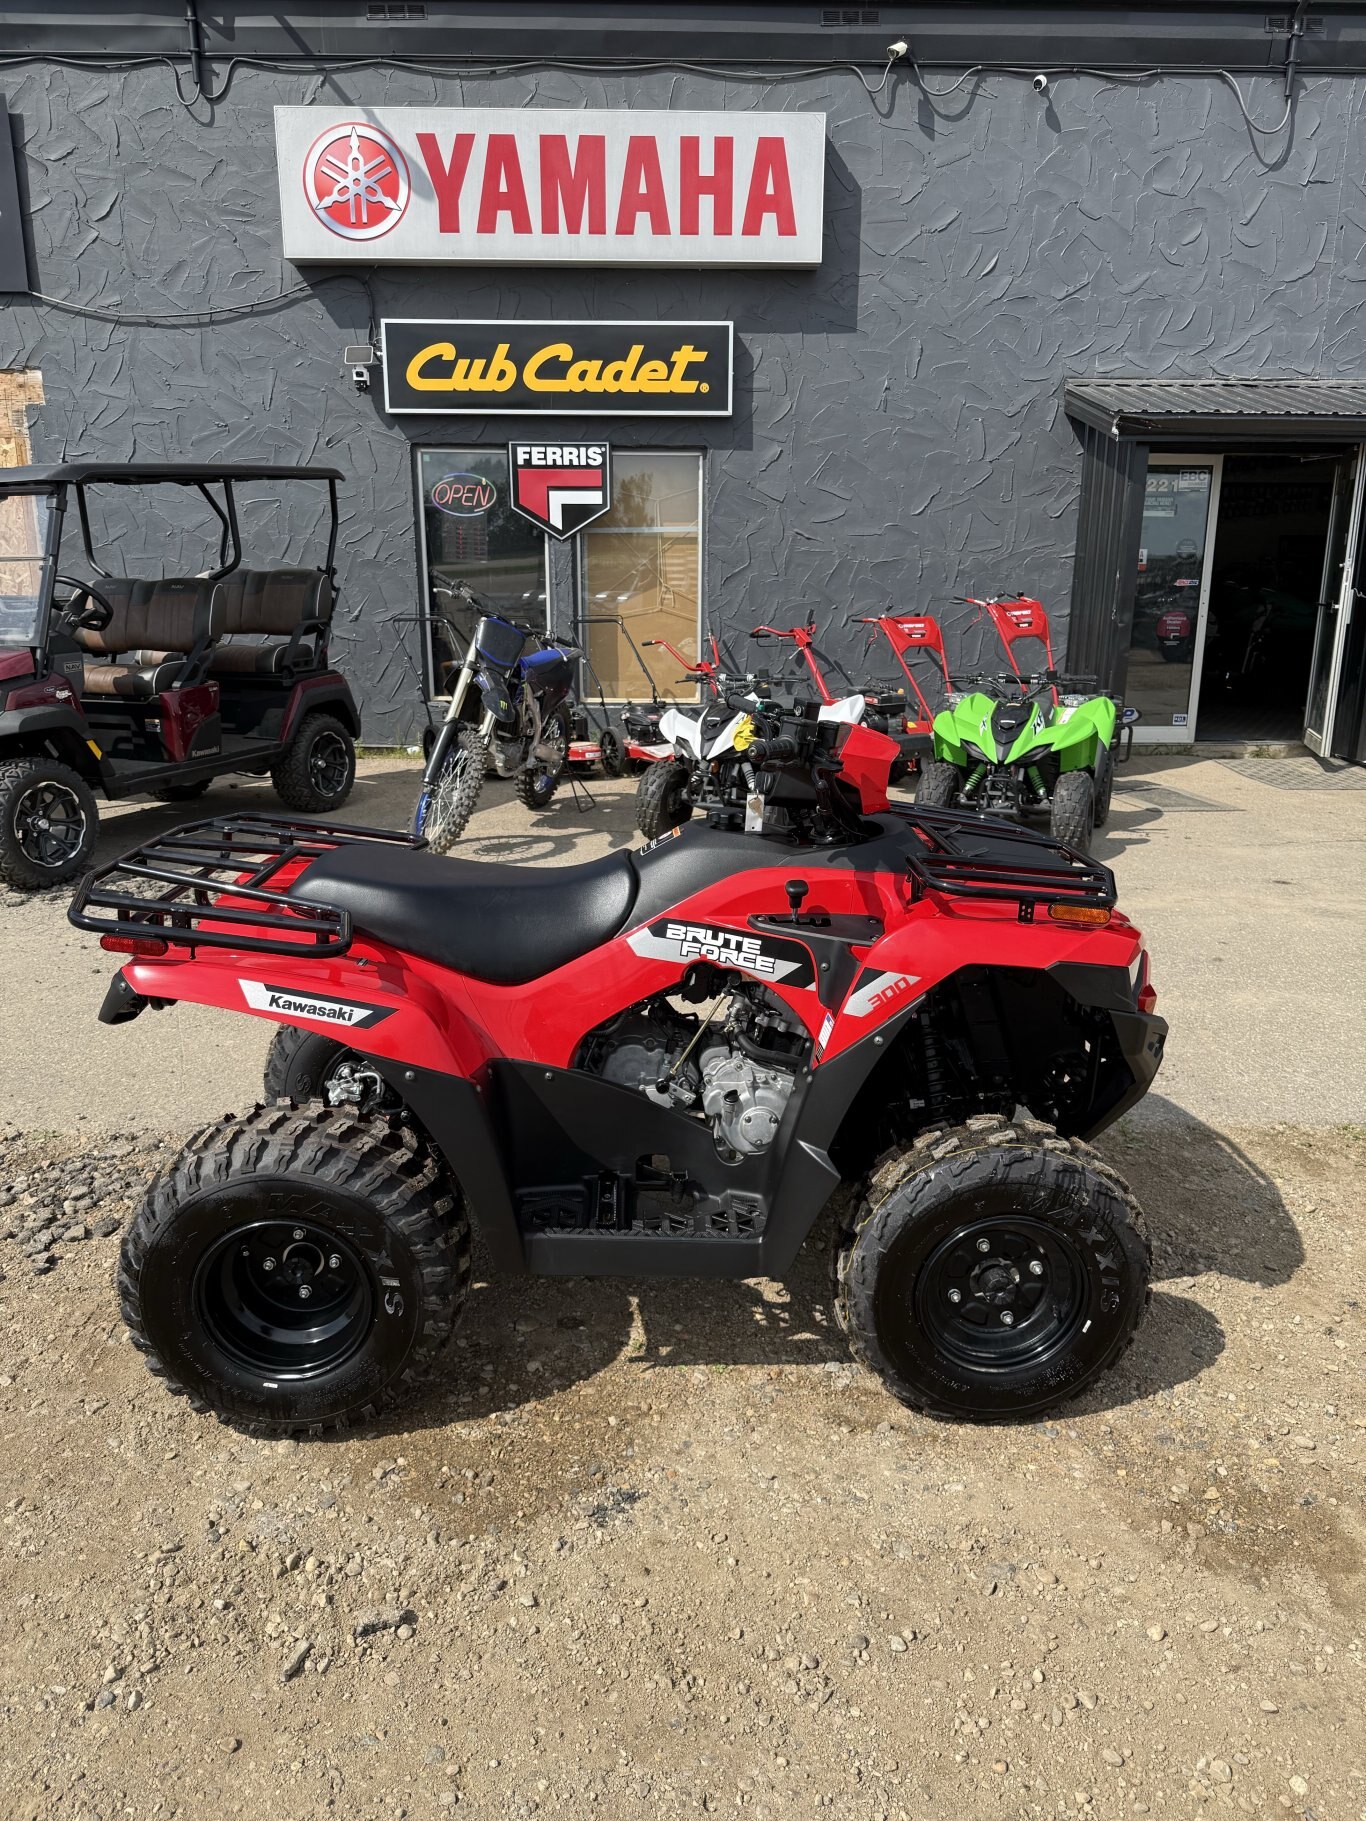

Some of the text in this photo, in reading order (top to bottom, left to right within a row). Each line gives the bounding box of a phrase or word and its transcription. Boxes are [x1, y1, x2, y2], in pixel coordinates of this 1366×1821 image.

[416, 132, 798, 236] YAMAHA
[405, 342, 518, 392] Cub
[516, 446, 603, 466] FERRIS
[1181, 471, 1207, 482] EBC
[435, 484, 490, 506] OPEN
[65, 663, 82, 671] NAV
[191, 745, 220, 758] Kawasaki
[665, 923, 762, 955] BRUTE
[680, 941, 777, 974] FORCE
[867, 976, 912, 1011] 300
[268, 994, 355, 1022] Kawasaki
